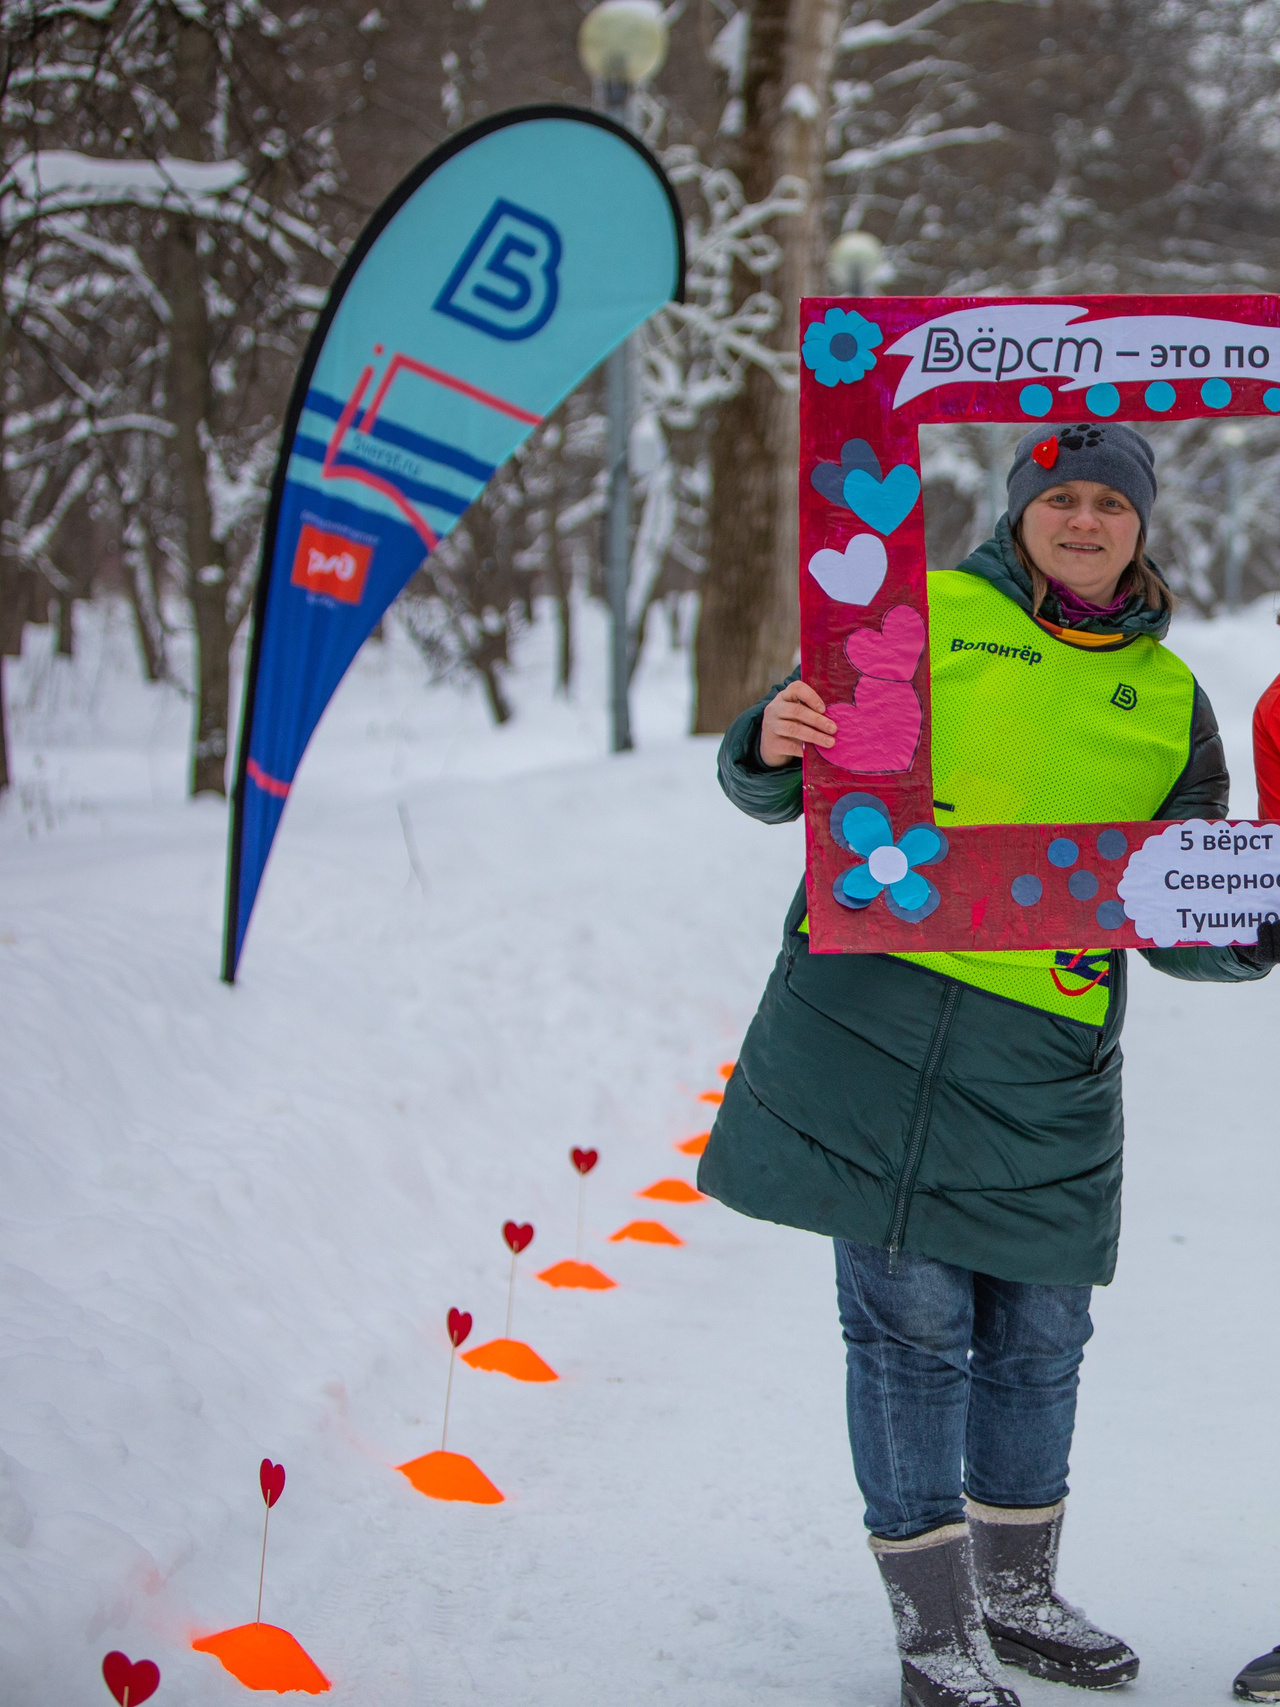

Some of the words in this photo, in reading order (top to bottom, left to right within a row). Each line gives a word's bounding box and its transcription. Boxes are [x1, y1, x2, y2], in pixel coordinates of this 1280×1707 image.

[1150, 345, 1210, 368] это
[1224, 345, 1270, 368] по
[950, 638, 1043, 666] Волонтёр
[1180, 830, 1194, 851] 5
[1203, 829, 1273, 855] вёрст
